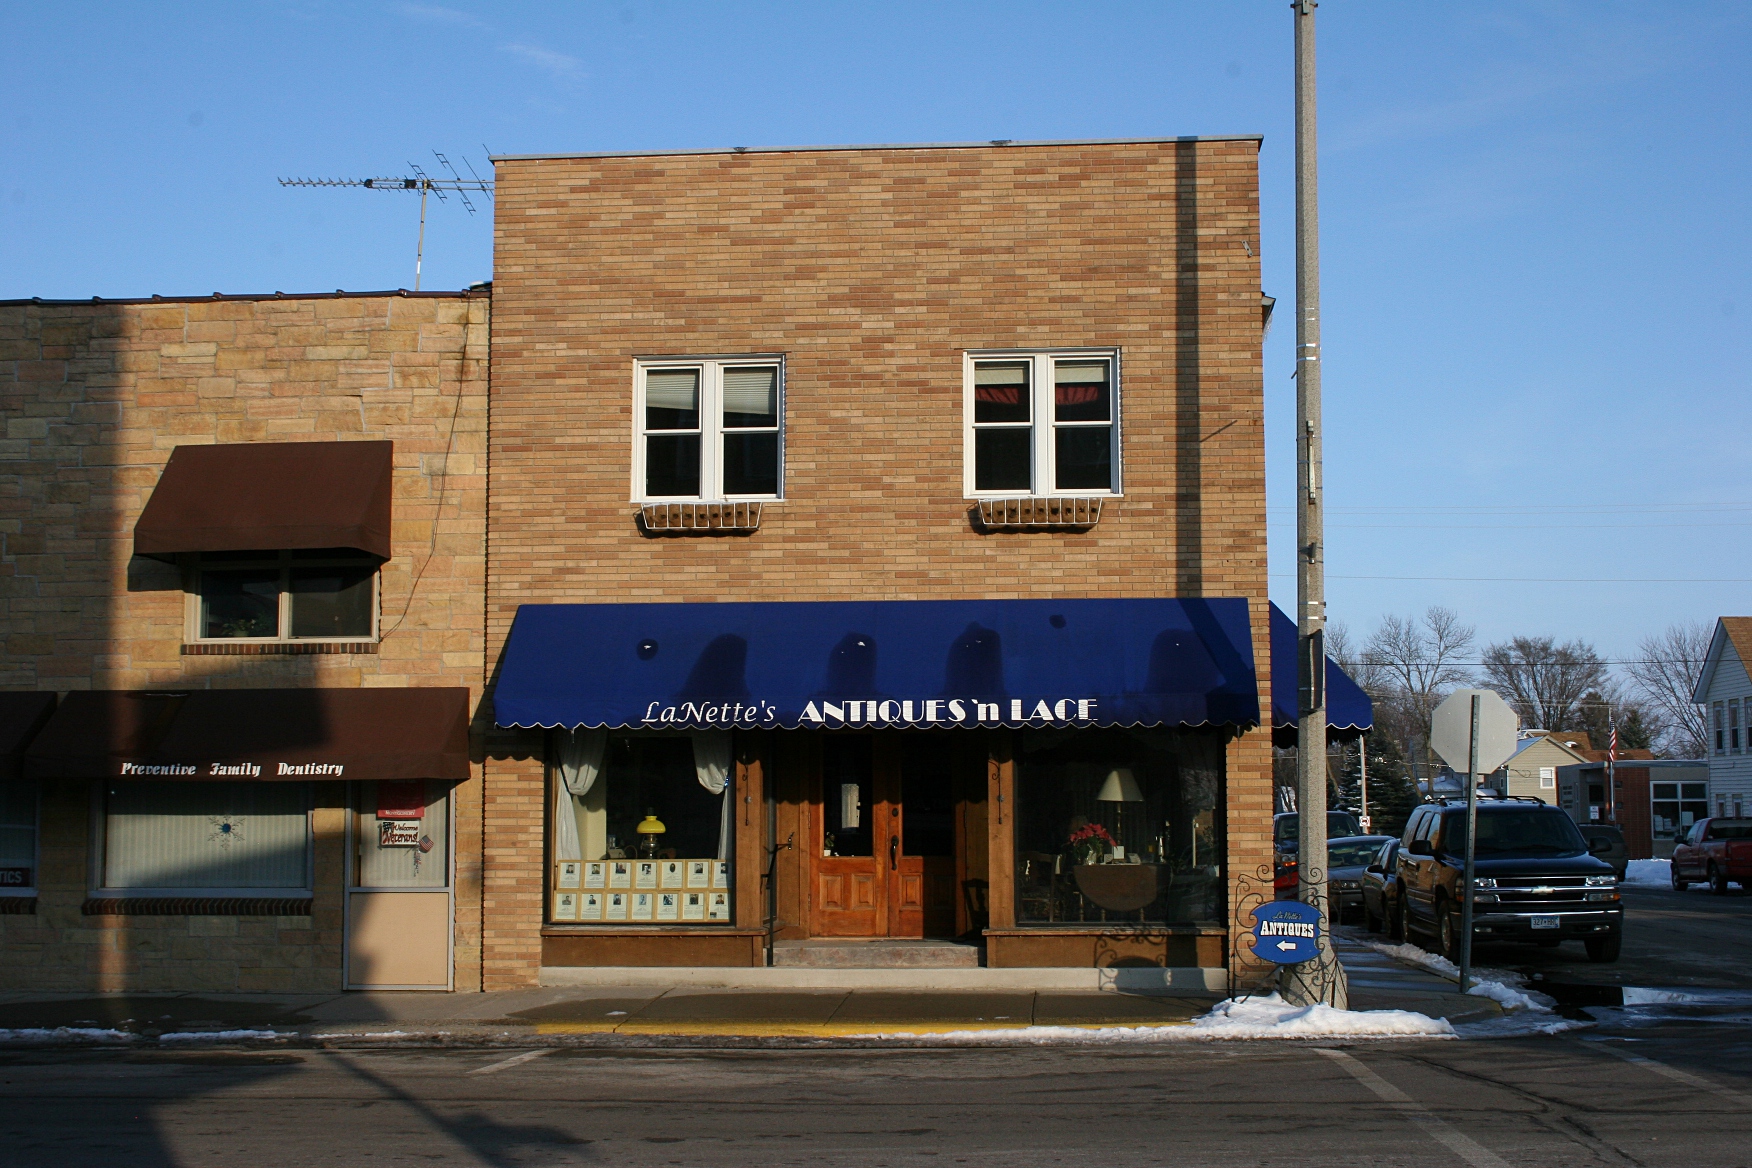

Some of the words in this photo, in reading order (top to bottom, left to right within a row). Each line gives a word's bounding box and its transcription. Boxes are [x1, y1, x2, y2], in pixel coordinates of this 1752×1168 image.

[641, 700, 776, 723] LaNette's
[798, 699, 966, 723] ANTIQUES
[1011, 698, 1098, 722] LACE
[121, 762, 197, 776] Preventive
[210, 762, 261, 777] Family
[277, 762, 344, 777] Dentistry
